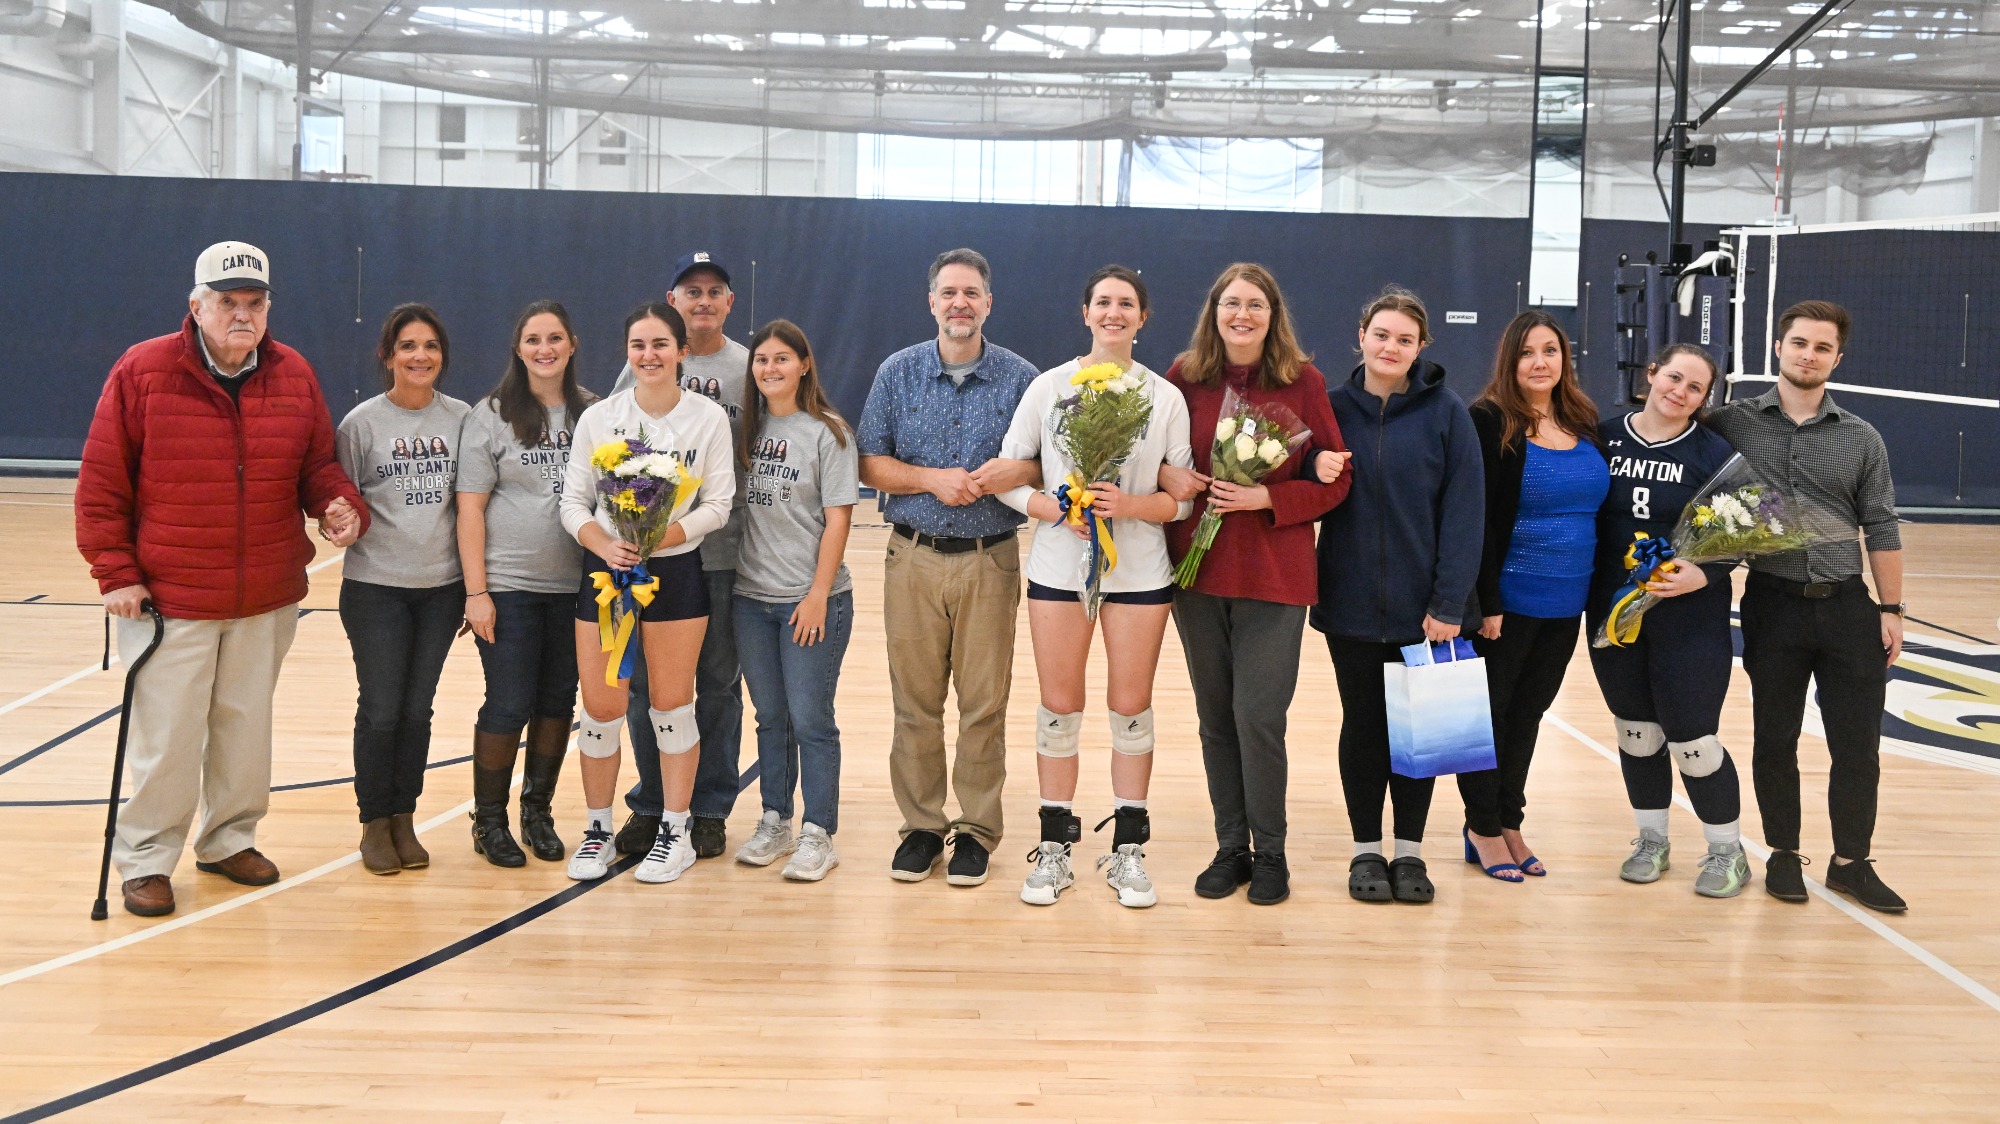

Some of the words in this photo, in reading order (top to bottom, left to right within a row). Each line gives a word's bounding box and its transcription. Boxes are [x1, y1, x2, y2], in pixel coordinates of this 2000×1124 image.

[222, 254, 263, 272] CANTON
[521, 451, 555, 466] SUNY
[376, 462, 410, 478] SUNY
[416, 460, 458, 475] CANTO
[758, 462, 800, 482] CANTON
[1610, 456, 1684, 483] CANTON
[394, 474, 451, 491] SENIORS
[745, 474, 779, 493] ENIORS
[405, 490, 443, 506] 2025
[747, 490, 773, 506] 2025
[1631, 486, 1651, 520] 8
